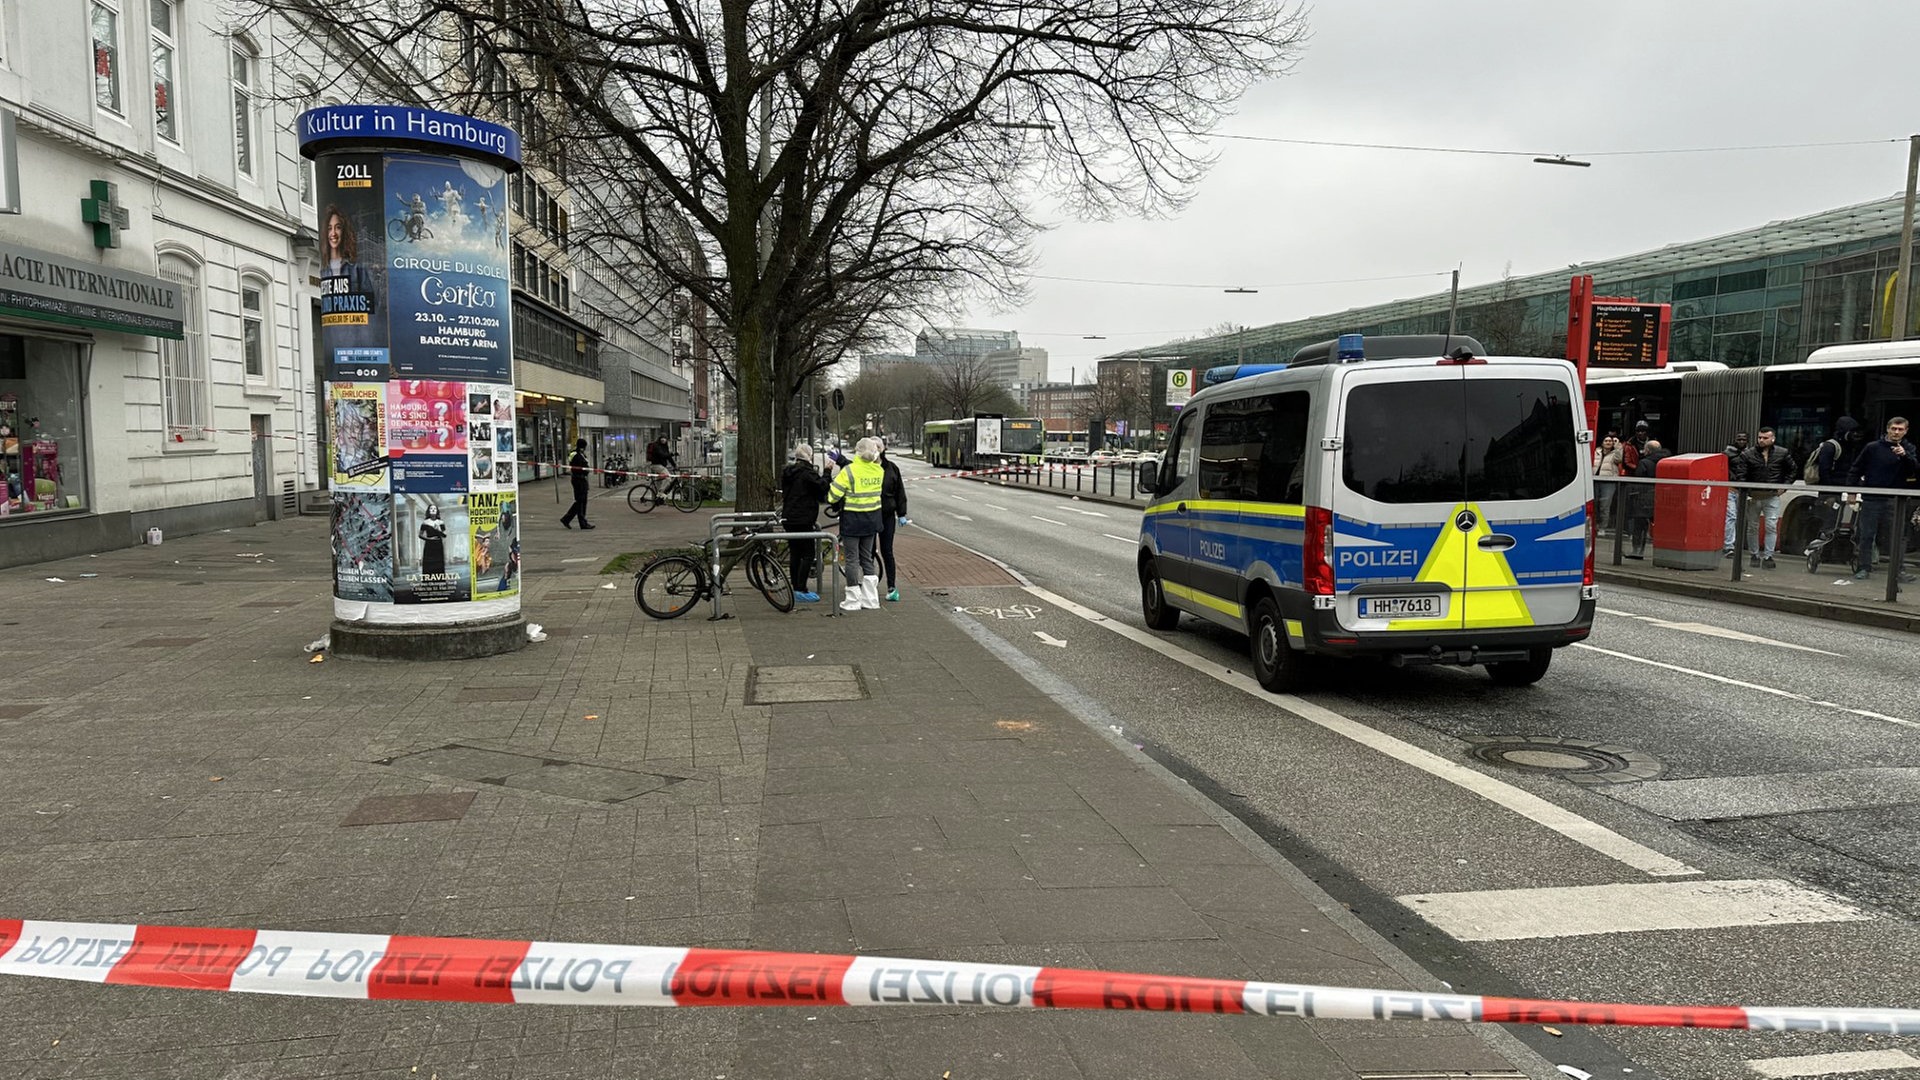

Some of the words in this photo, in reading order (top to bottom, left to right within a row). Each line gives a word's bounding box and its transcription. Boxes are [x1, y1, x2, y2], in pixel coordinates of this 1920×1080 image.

[307, 110, 363, 134] Kultur
[374, 110, 395, 130] in
[408, 112, 506, 153] Hamburg
[337, 164, 372, 179] ZOLL
[393, 257, 451, 274] CIRQUE
[455, 262, 473, 274] DU
[0, 253, 45, 284] ACIE
[47, 262, 173, 309] INTERNATIONALE
[334, 278, 349, 295] AUS
[421, 276, 496, 308] Corteo
[333, 295, 370, 312] PRAXIS:
[415, 312, 447, 323] 23.10.
[458, 315, 499, 328] 27.10.2024
[438, 326, 486, 338] HAMBURG
[420, 336, 470, 347] BARCLAYS
[472, 339, 498, 350] ARENA
[341, 390, 377, 398] EHRLICHER
[391, 411, 407, 419] WAS
[860, 477, 881, 486] POLIZE
[470, 493, 498, 508] TANZ
[470, 515, 498, 525] FESTIVAL
[1200, 540, 1225, 560] POLIZEI
[1340, 549, 1418, 567] POLIZEI
[360, 568, 375, 576] UND
[360, 575, 388, 584] LASSEN
[406, 574, 418, 582] LA
[419, 572, 461, 581] TRAVIATA
[1373, 600, 1391, 613] HH
[1399, 599, 1431, 612] 7618
